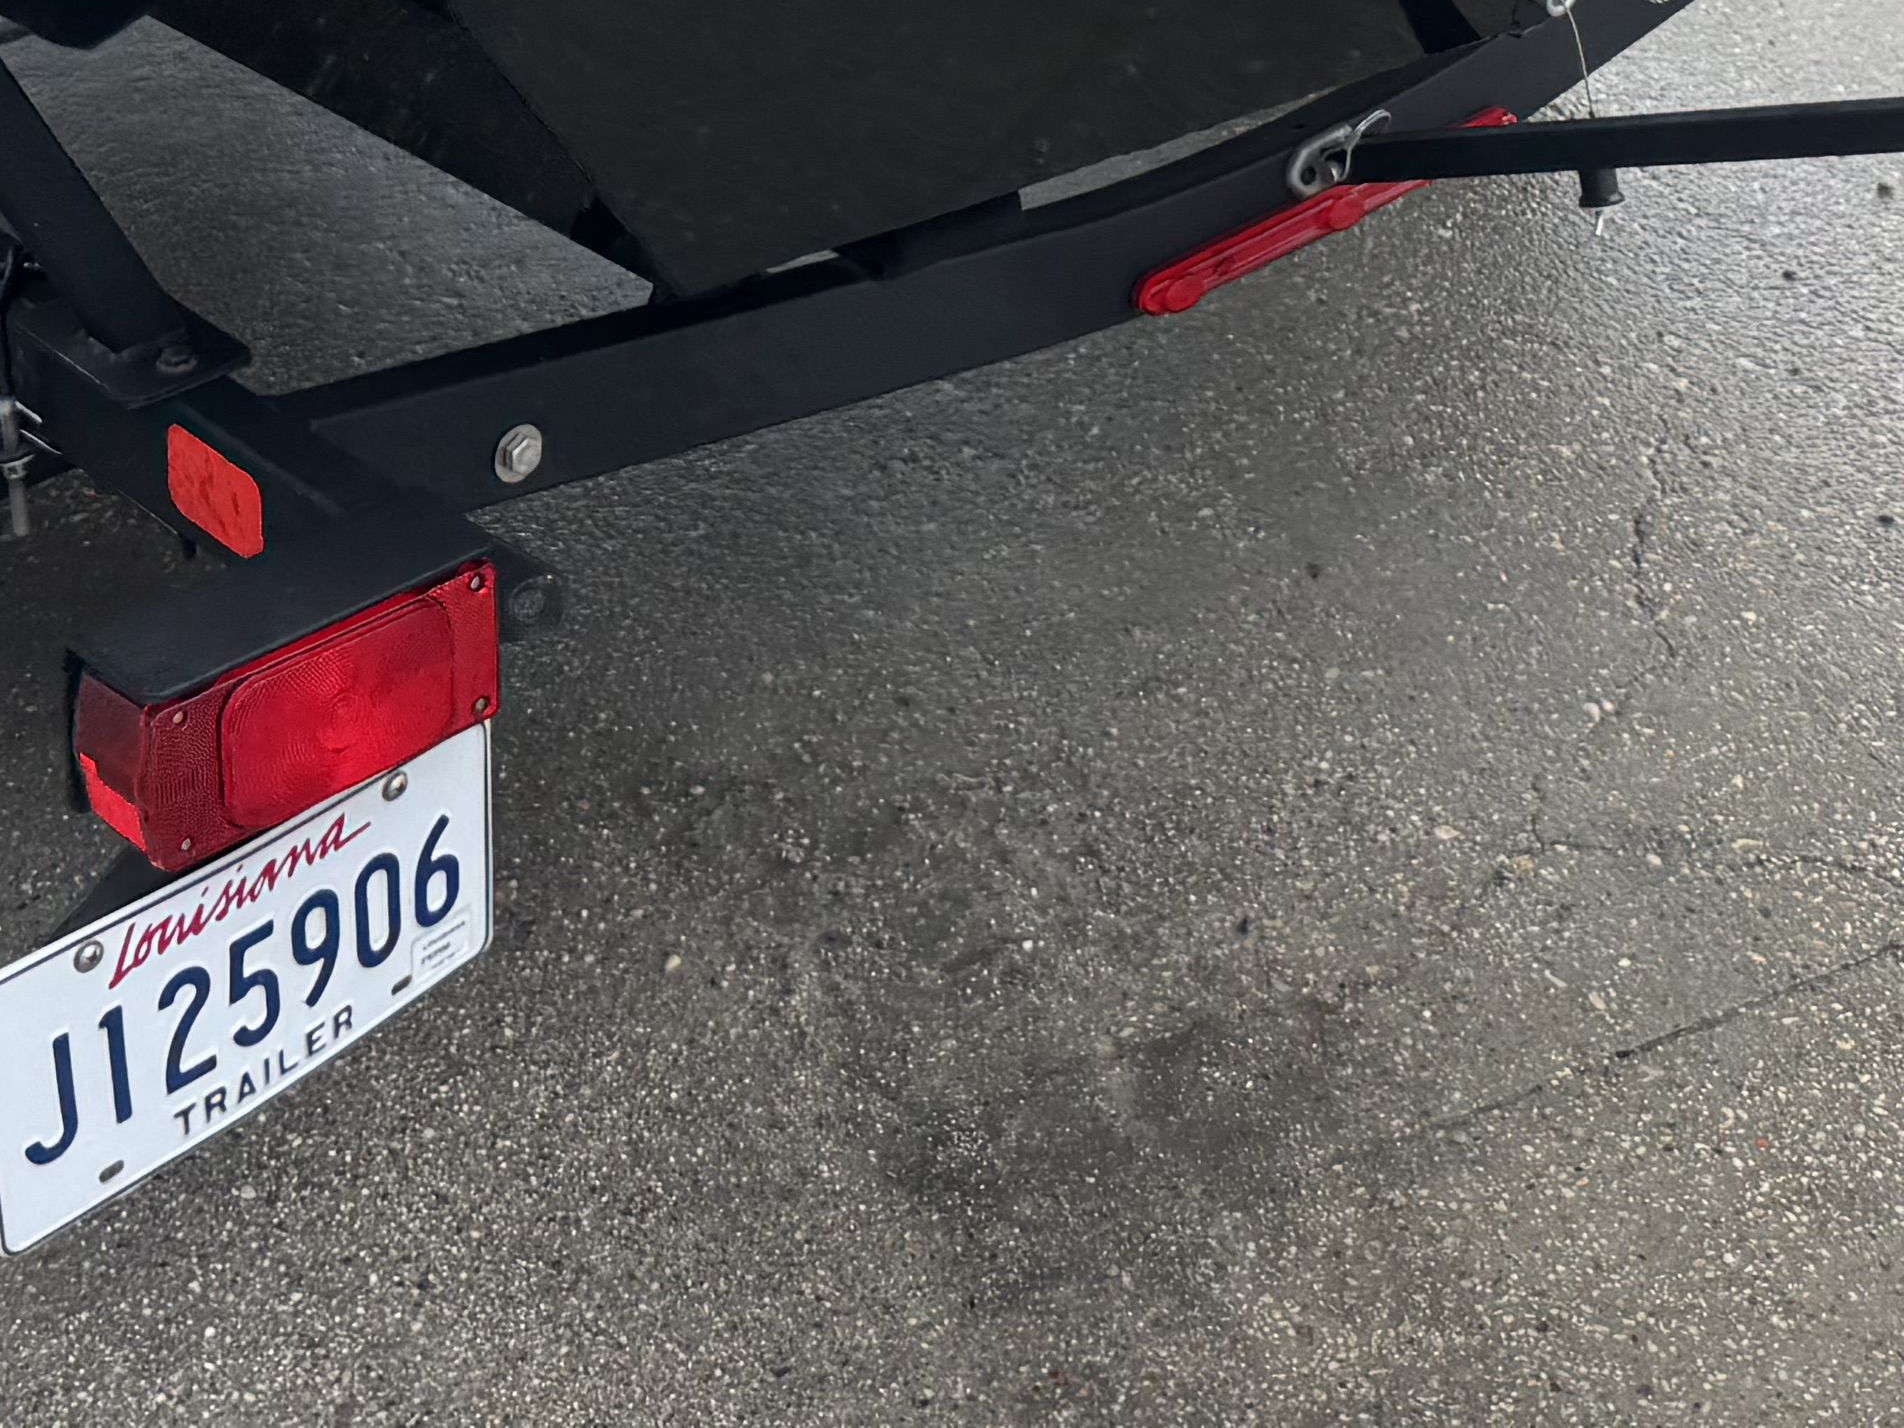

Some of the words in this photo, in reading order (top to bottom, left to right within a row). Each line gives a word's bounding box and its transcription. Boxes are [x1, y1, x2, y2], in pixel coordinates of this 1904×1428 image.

[24, 813, 461, 1167] J125906
[107, 811, 372, 990] Louisiana
[173, 1003, 354, 1137] TRAILER
